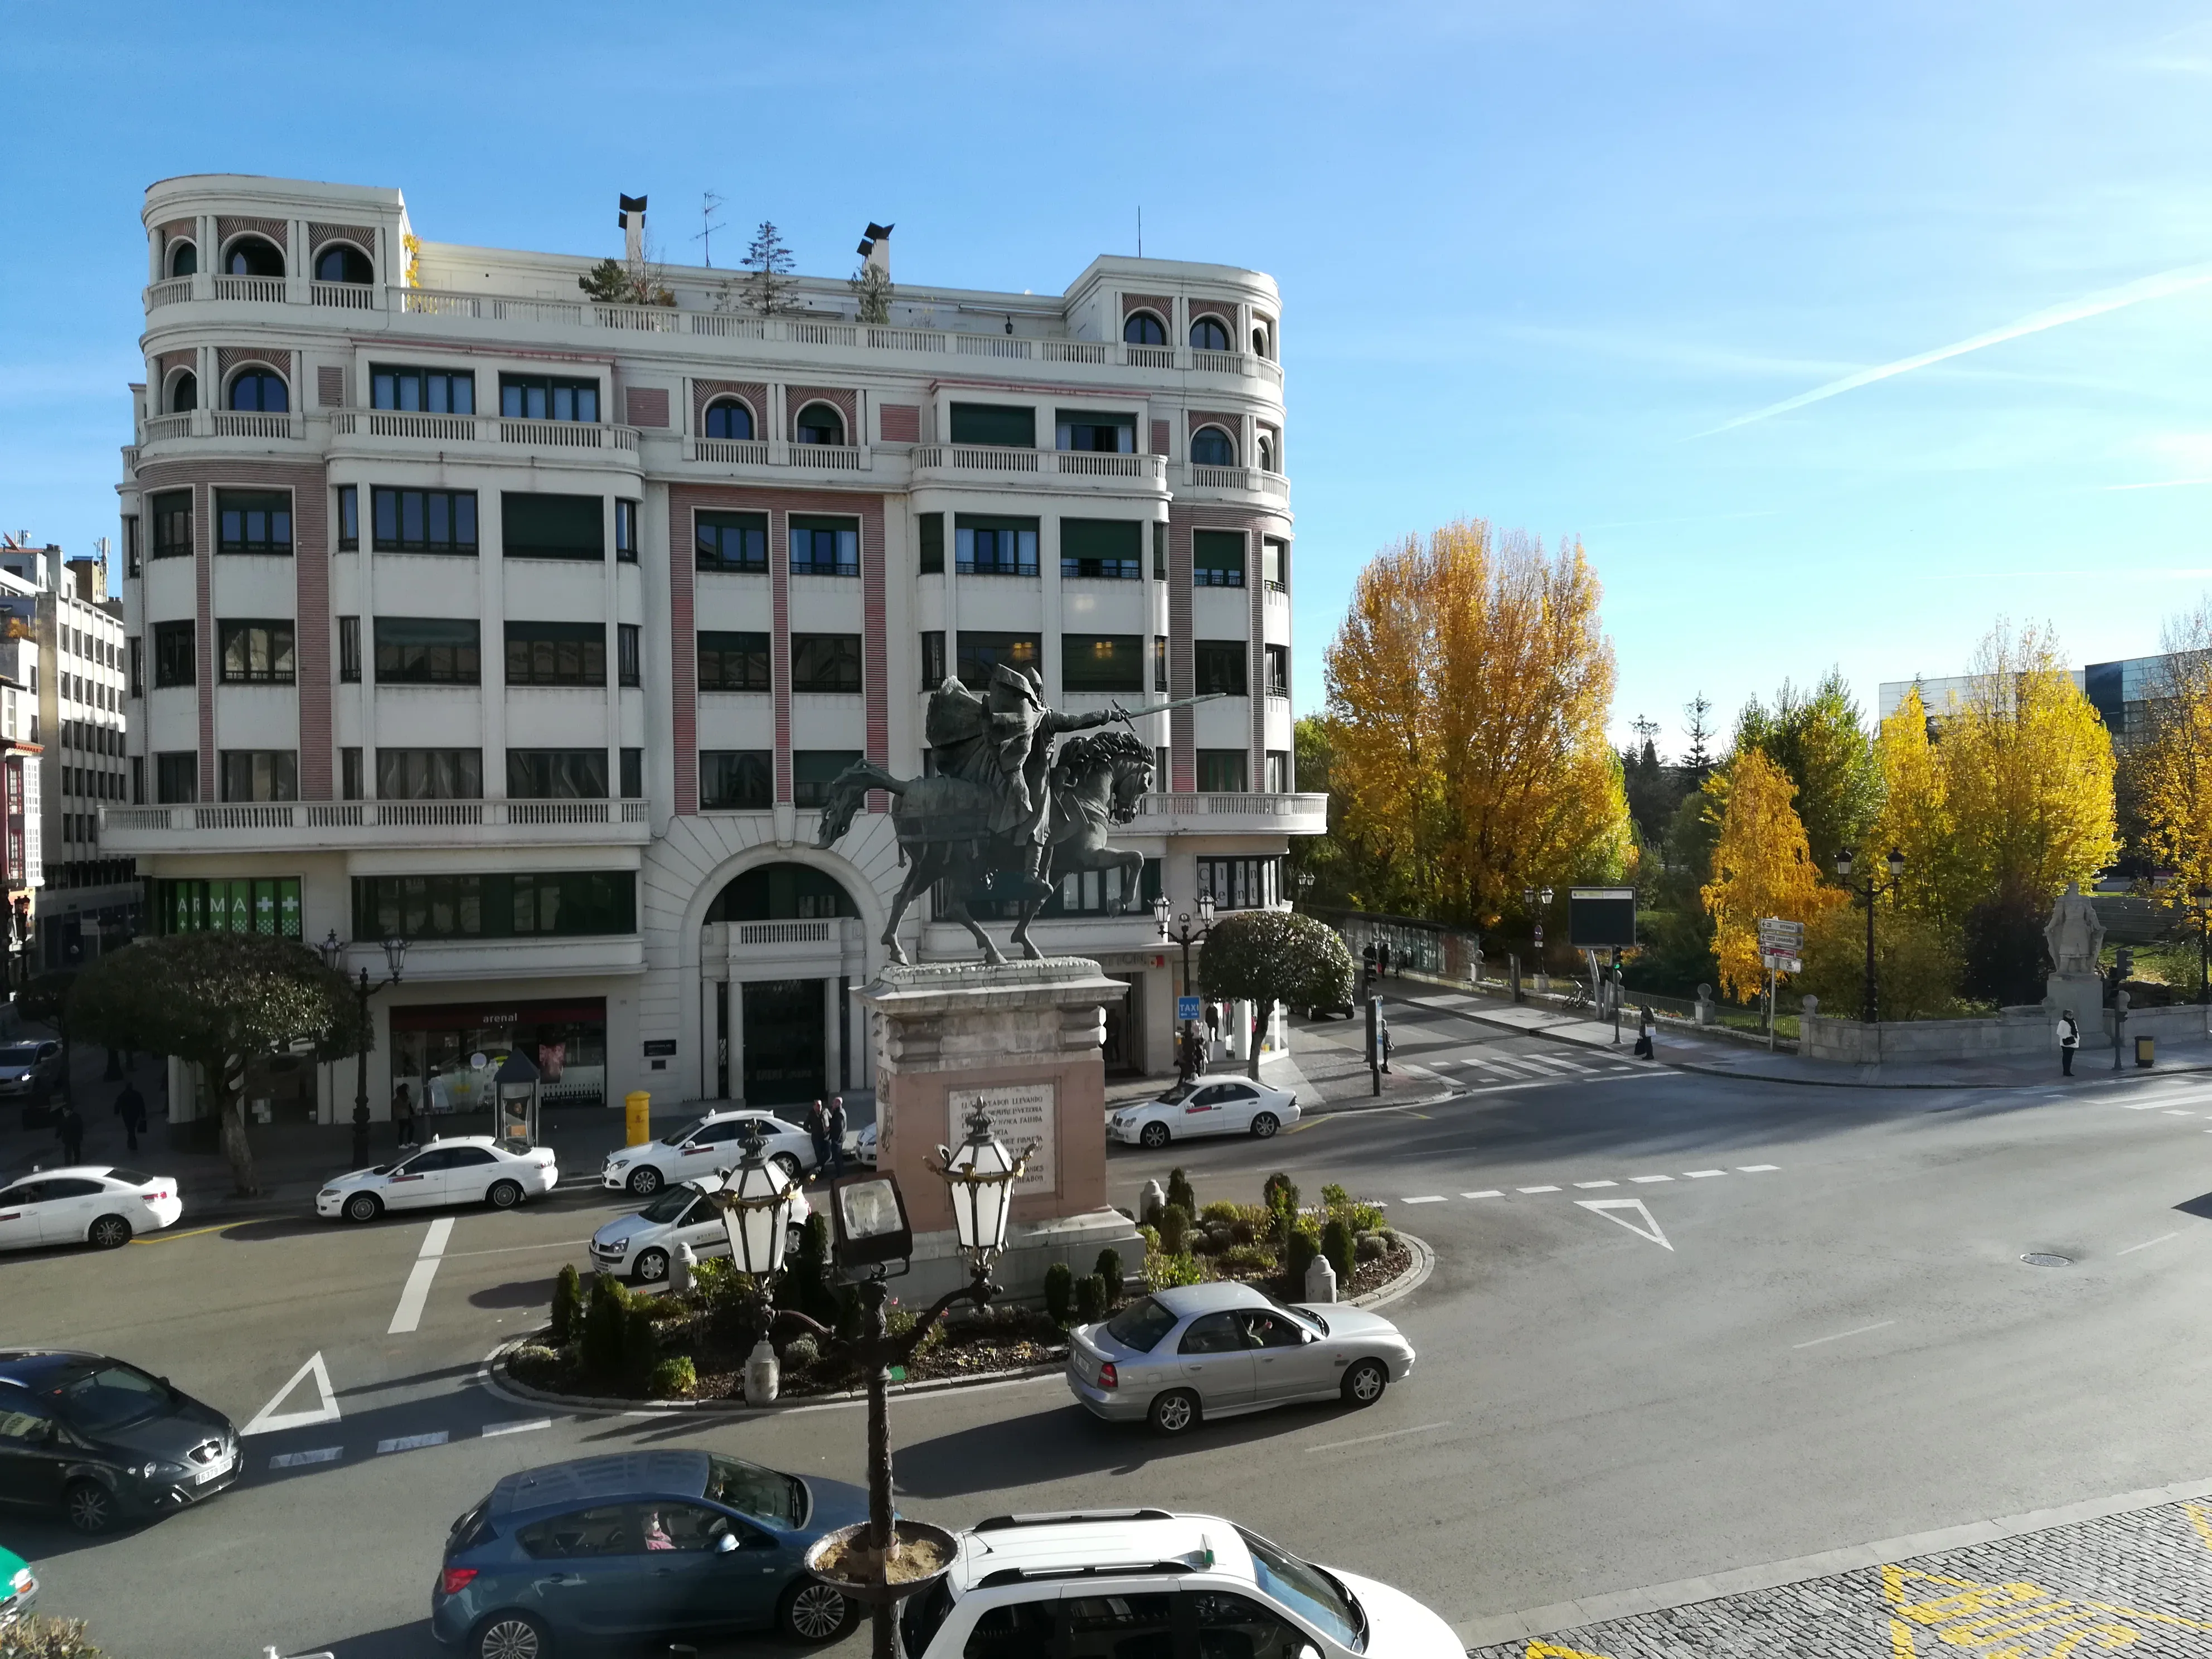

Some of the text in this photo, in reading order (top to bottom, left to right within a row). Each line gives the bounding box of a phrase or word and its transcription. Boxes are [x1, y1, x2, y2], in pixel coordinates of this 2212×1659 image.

[1180, 1003, 1199, 1012] TAXI
[483, 1012, 517, 1023] arenal
[201, 1467, 218, 1481] 6379
